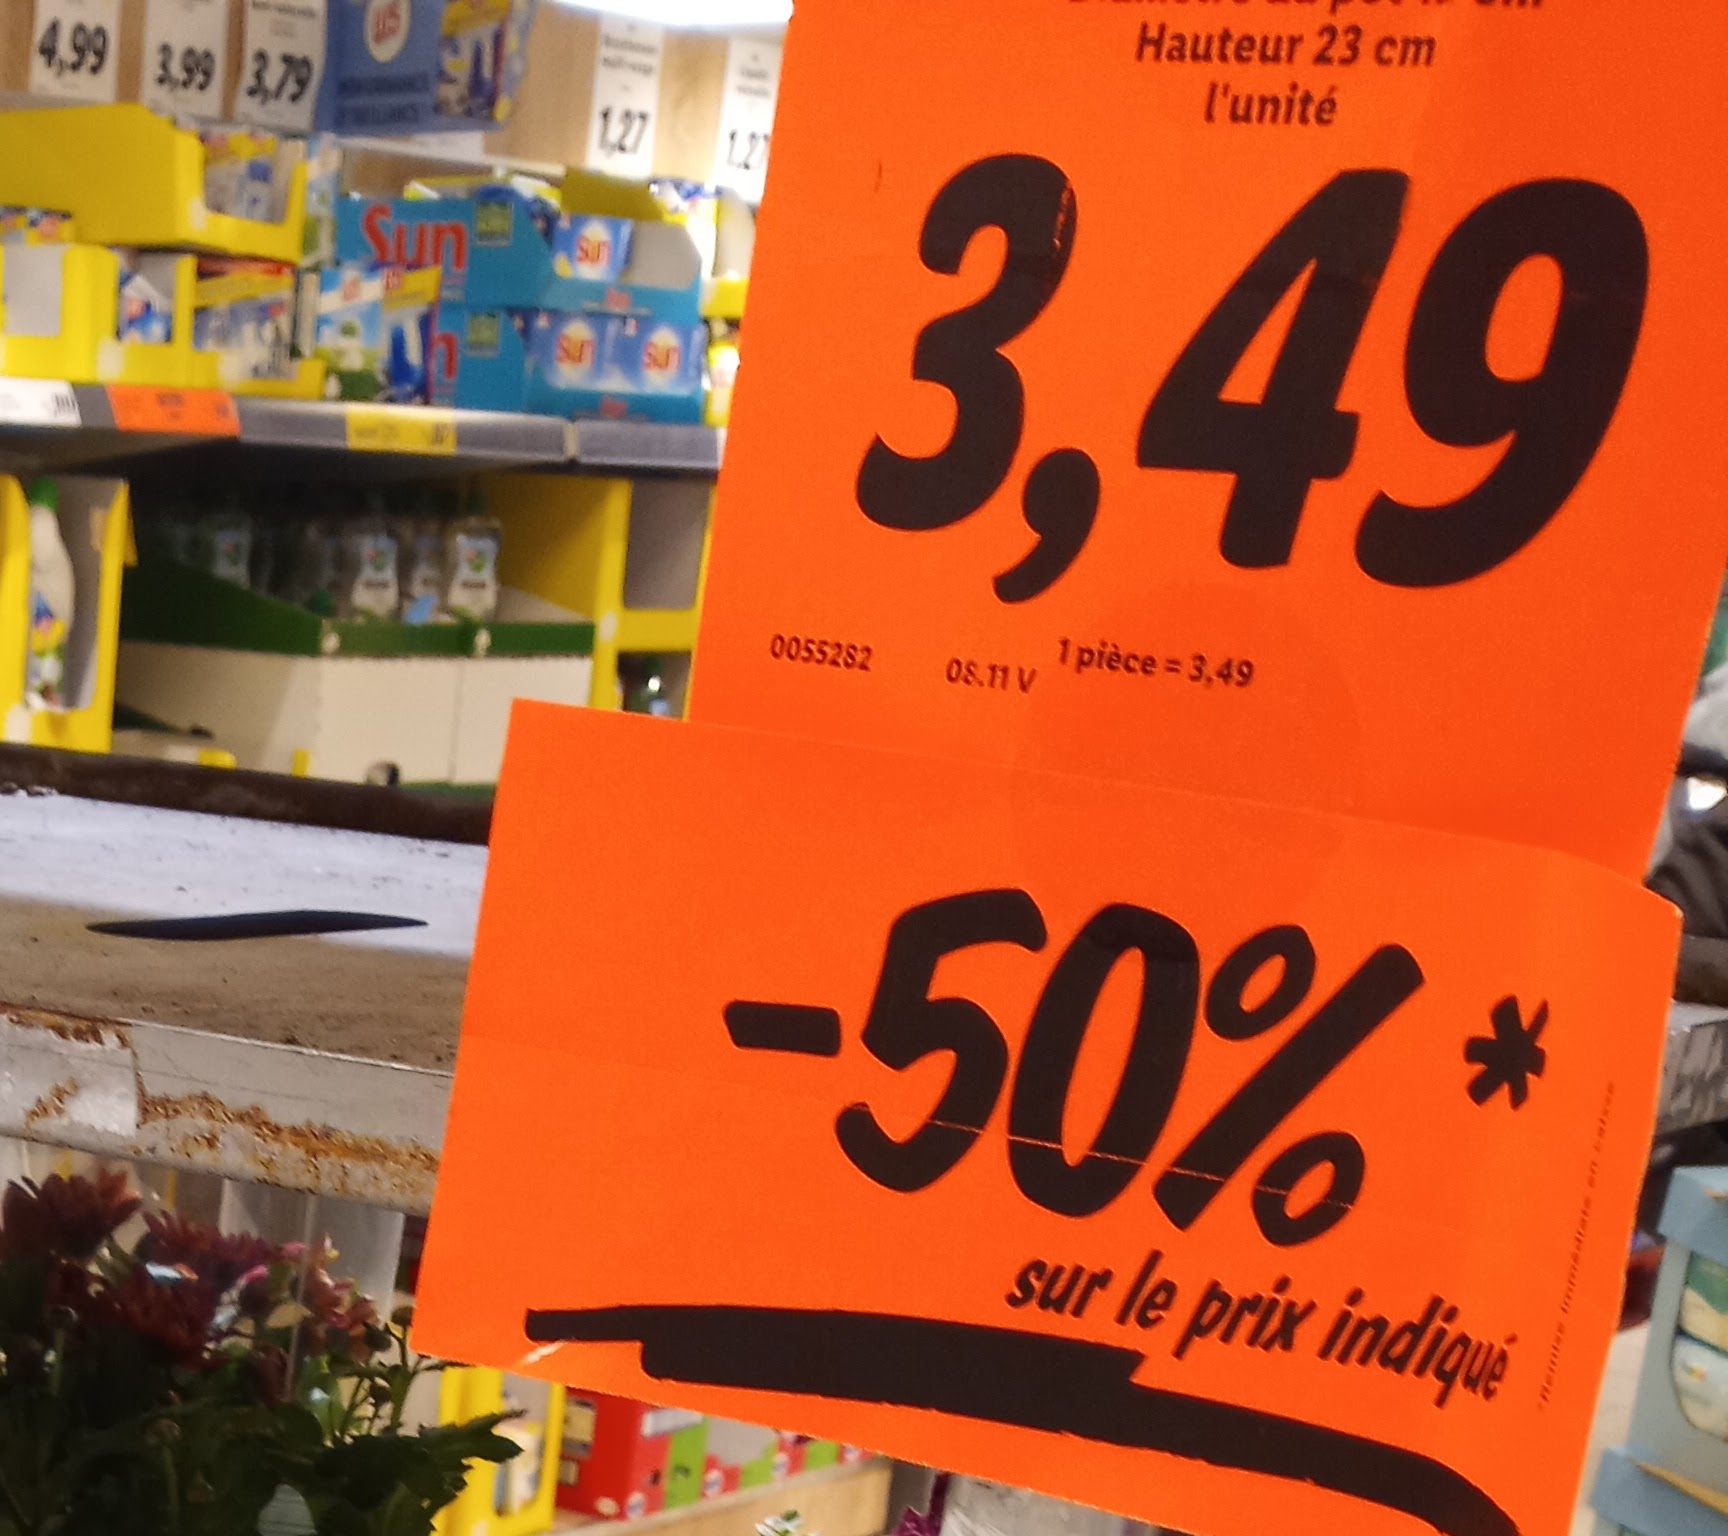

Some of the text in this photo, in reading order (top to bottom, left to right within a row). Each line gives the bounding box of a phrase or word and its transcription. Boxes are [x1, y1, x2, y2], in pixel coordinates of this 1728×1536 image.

[38, 16, 108, 76] 4,99
[1135, 20, 1437, 68] Hauteur 23 cm
[246, 48, 313, 104] 3,79
[1203, 81, 1338, 126] l'unité
[360, 203, 468, 273] Sun
[855, 152, 1651, 604] 3,49
[769, 633, 873, 672] 0055282
[1057, 637, 1070, 666] 1
[1074, 639, 1159, 677] pièce
[1188, 652, 1255, 690] 3,49
[1004, 1248, 1519, 1410] sur le prix indiqué
